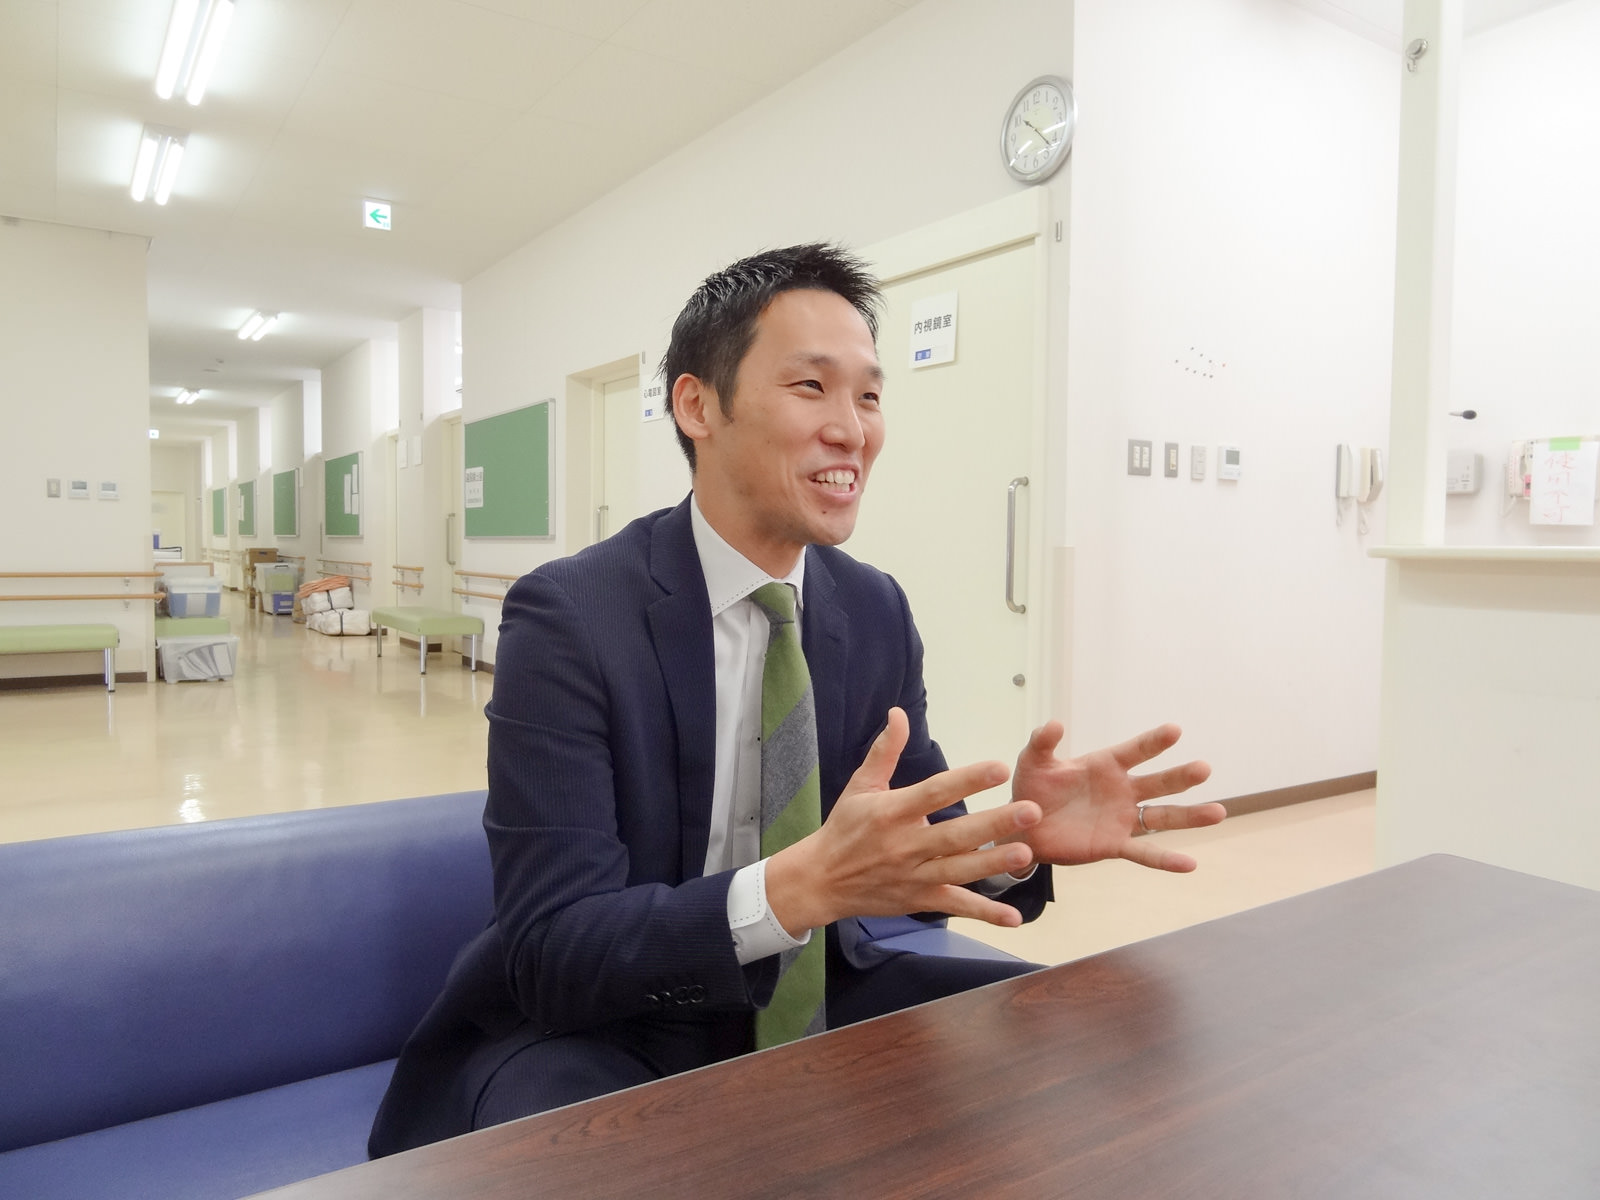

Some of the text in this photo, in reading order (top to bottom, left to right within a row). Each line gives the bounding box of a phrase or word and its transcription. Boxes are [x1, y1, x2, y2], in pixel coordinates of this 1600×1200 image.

[1033, 90, 1040, 104] 12
[1052, 96, 1058, 110] 2
[1023, 99, 1029, 112] 11
[1014, 114, 1021, 128] 10
[914, 314, 952, 335] 内視鏡室
